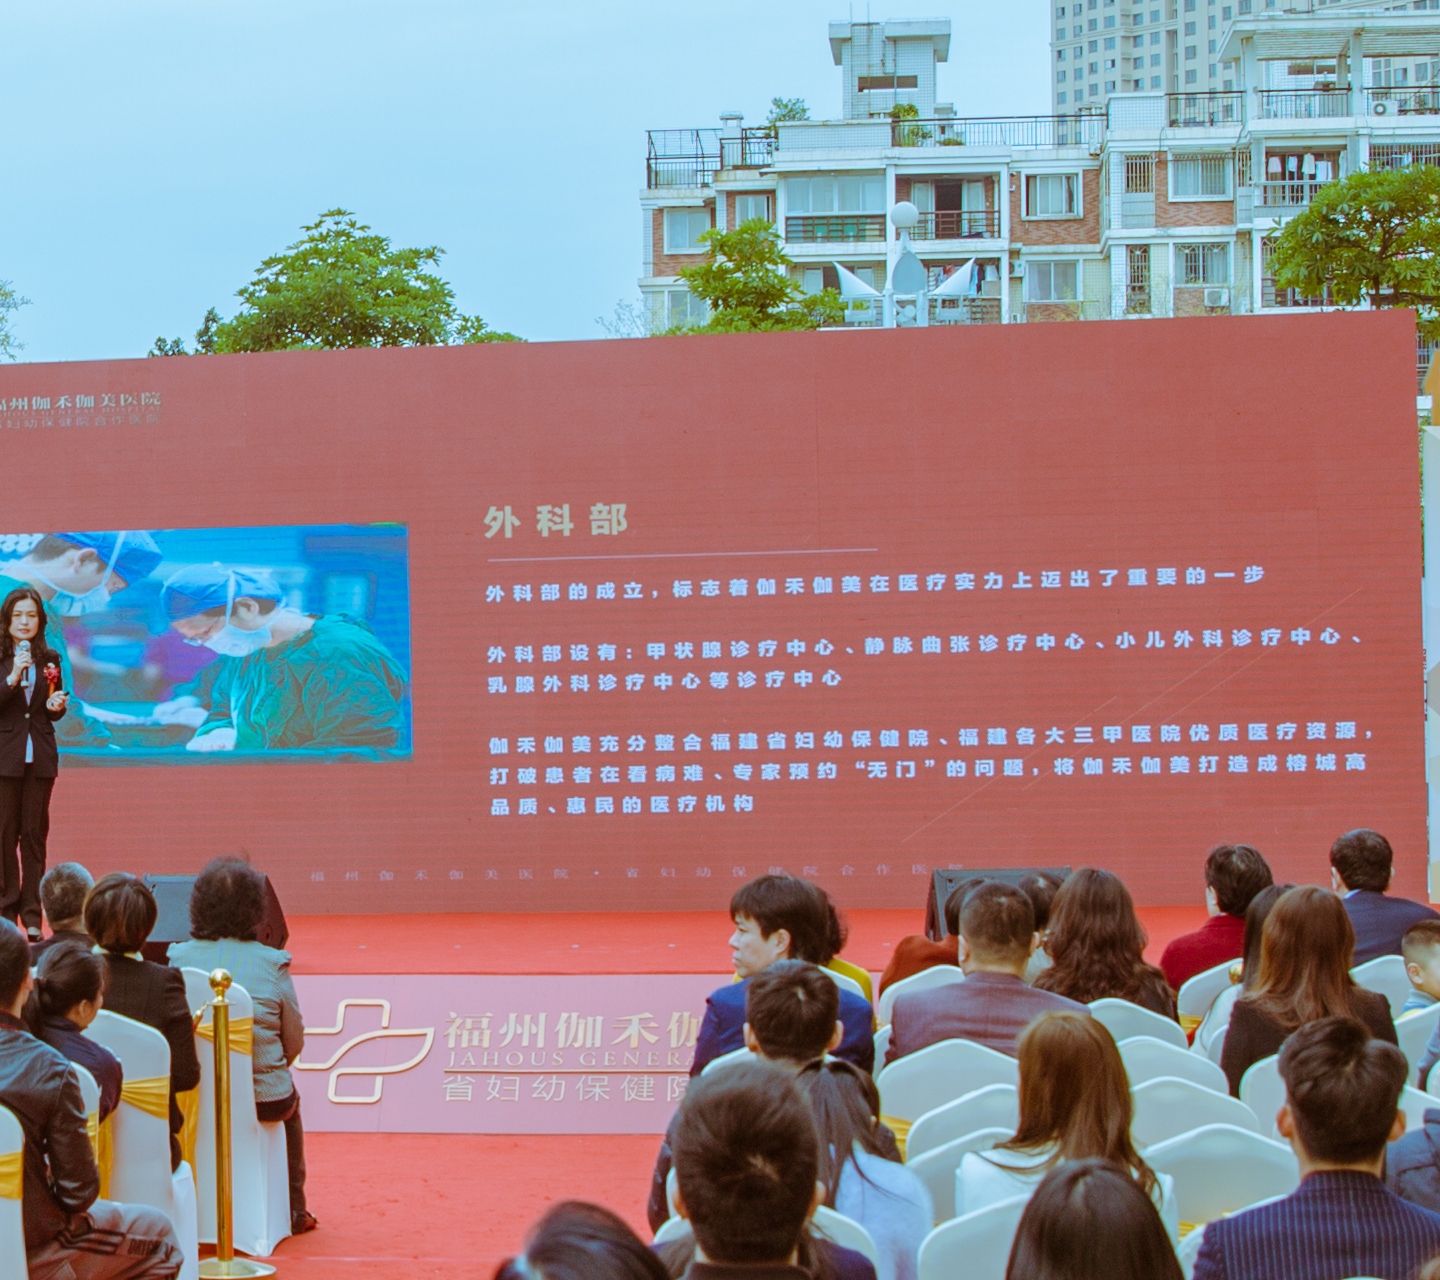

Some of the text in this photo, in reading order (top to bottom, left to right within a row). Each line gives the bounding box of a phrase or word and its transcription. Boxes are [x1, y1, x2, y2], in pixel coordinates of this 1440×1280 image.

[483, 503, 628, 539] 外科部
[487, 668, 842, 694] 乳腺外科诊疗中心等诊疗中心
[490, 794, 754, 816] 品质、惠民的医疗机构
[448, 1051, 564, 1068] JAHOUS
